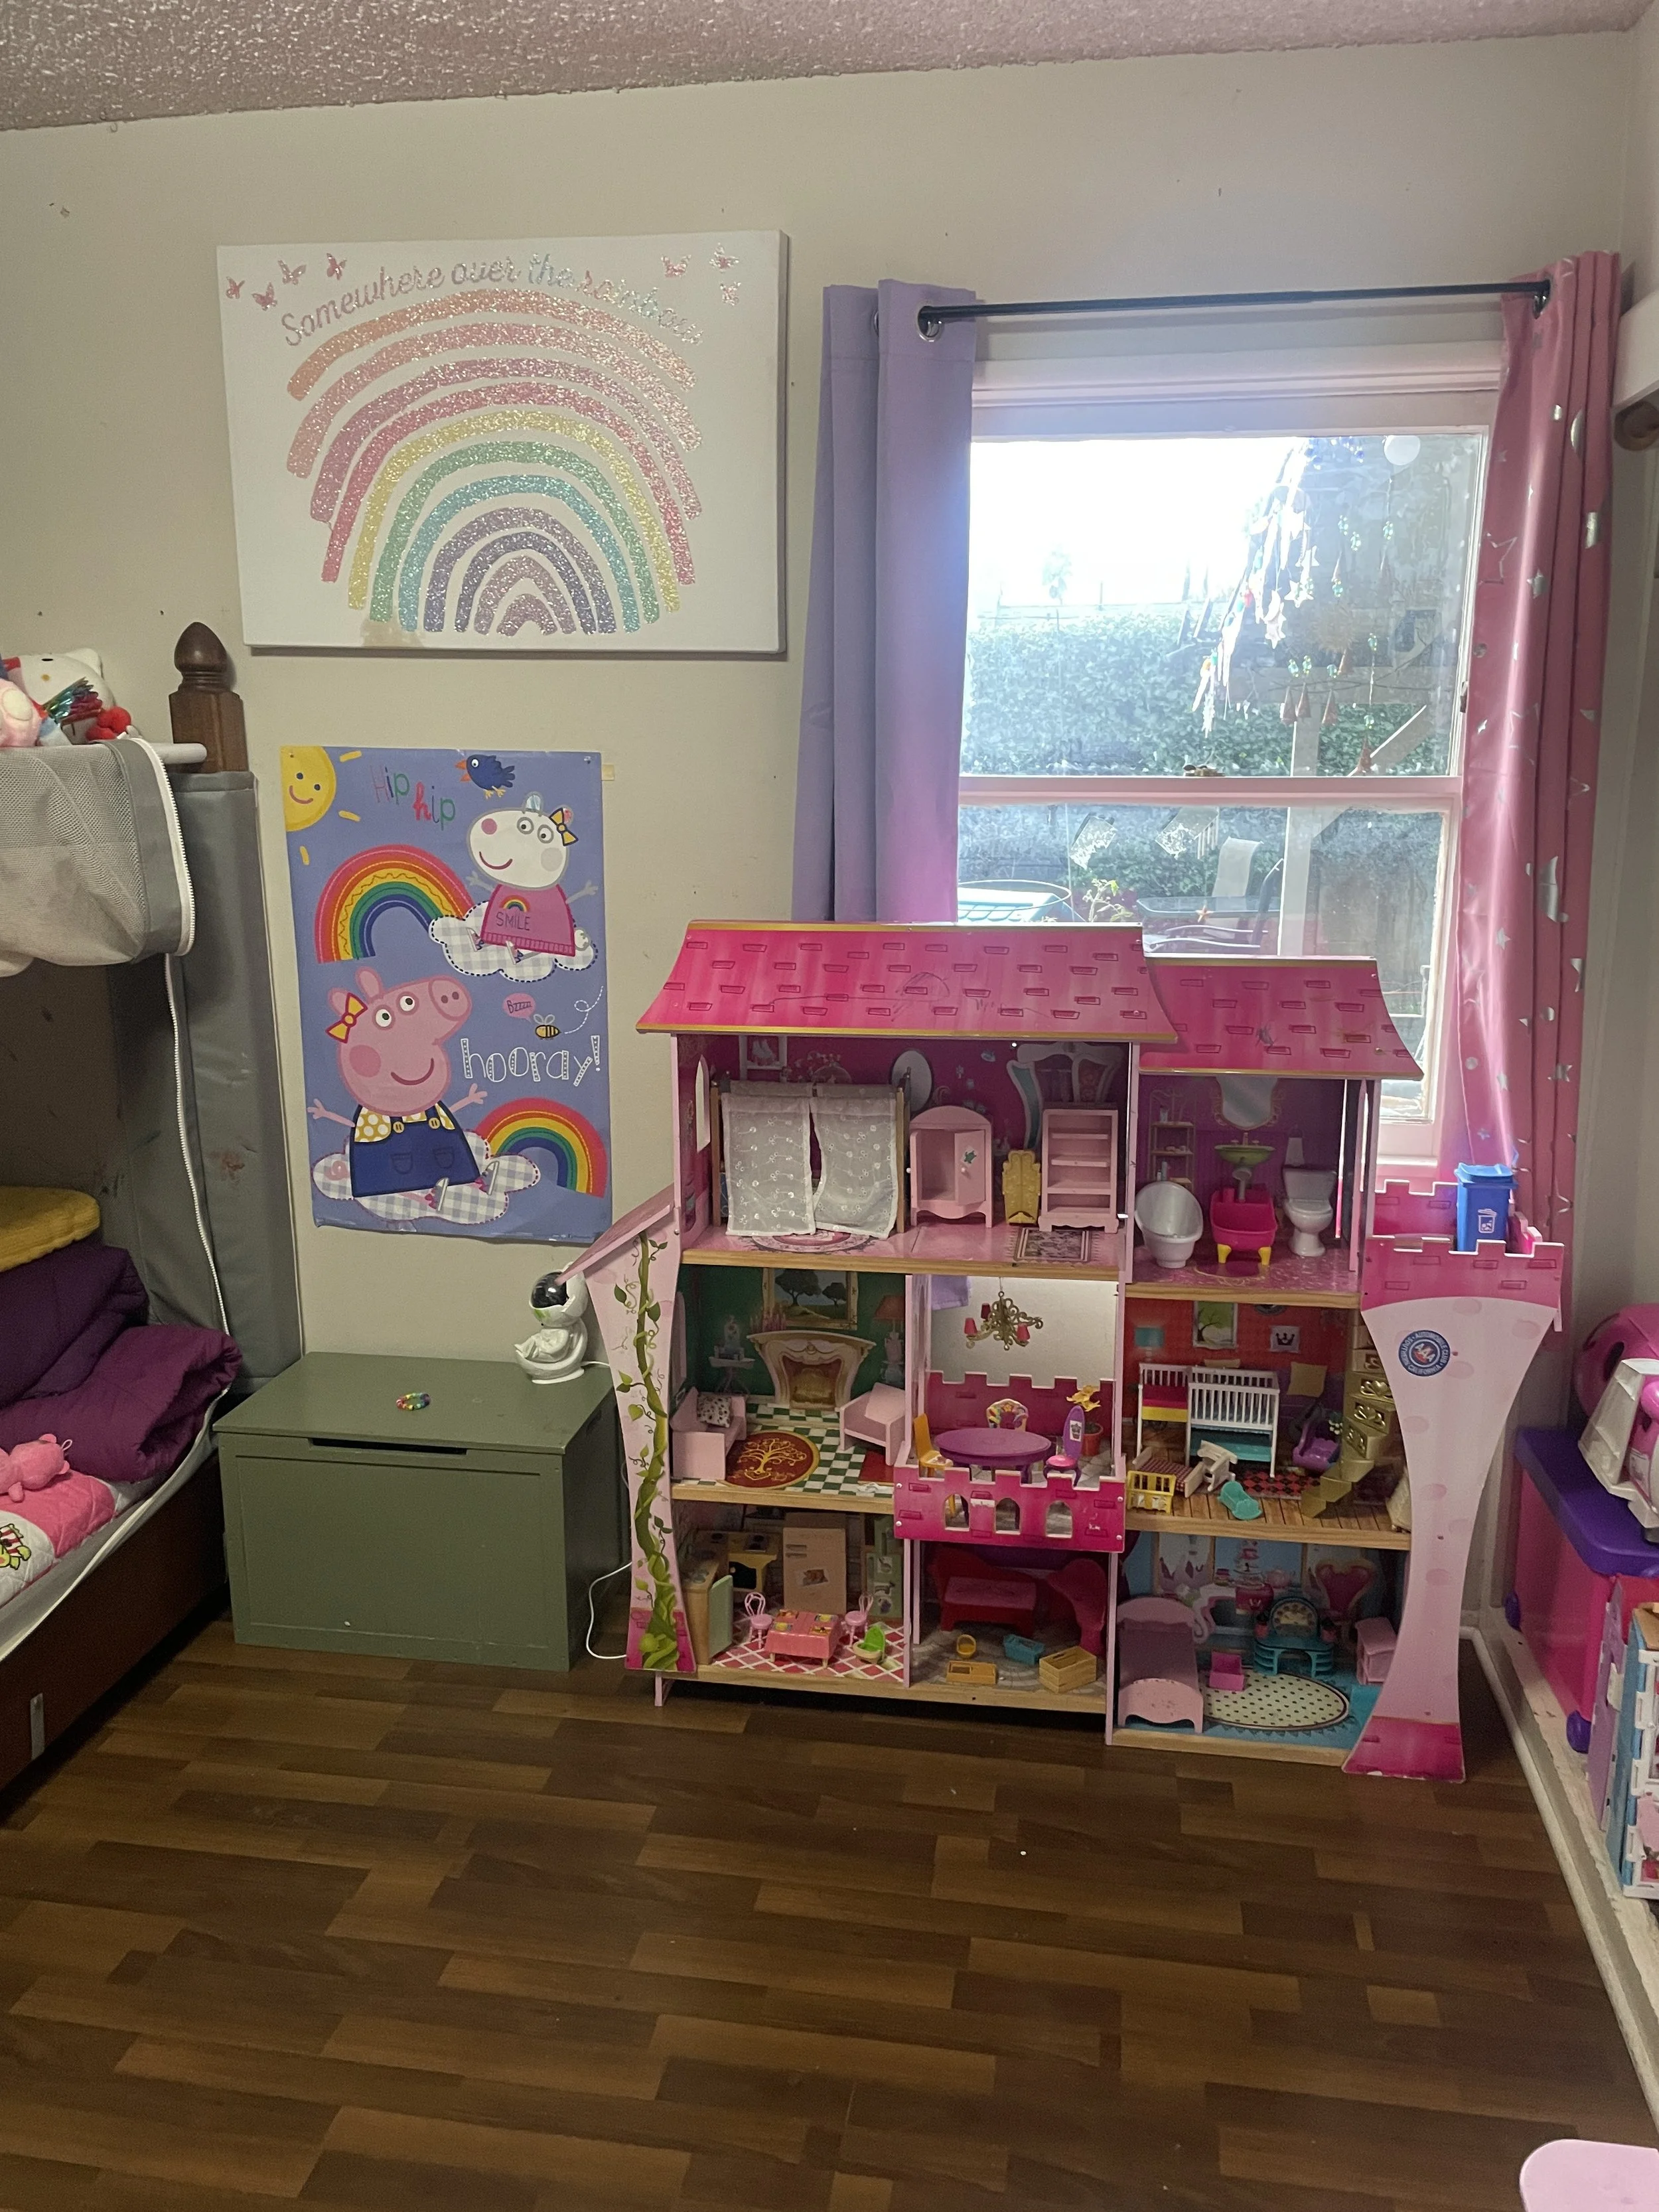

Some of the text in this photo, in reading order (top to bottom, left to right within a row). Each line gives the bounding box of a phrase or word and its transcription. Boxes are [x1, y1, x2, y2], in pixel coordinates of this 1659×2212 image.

[281, 265, 445, 346] Somewhere
[451, 255, 522, 285] over
[528, 254, 575, 287] the
[370, 765, 456, 832] Hip hip
[496, 911, 530, 931] SMILE
[461, 1035, 601, 1086] hooray!
[1414, 1343, 1435, 1362] AAA
